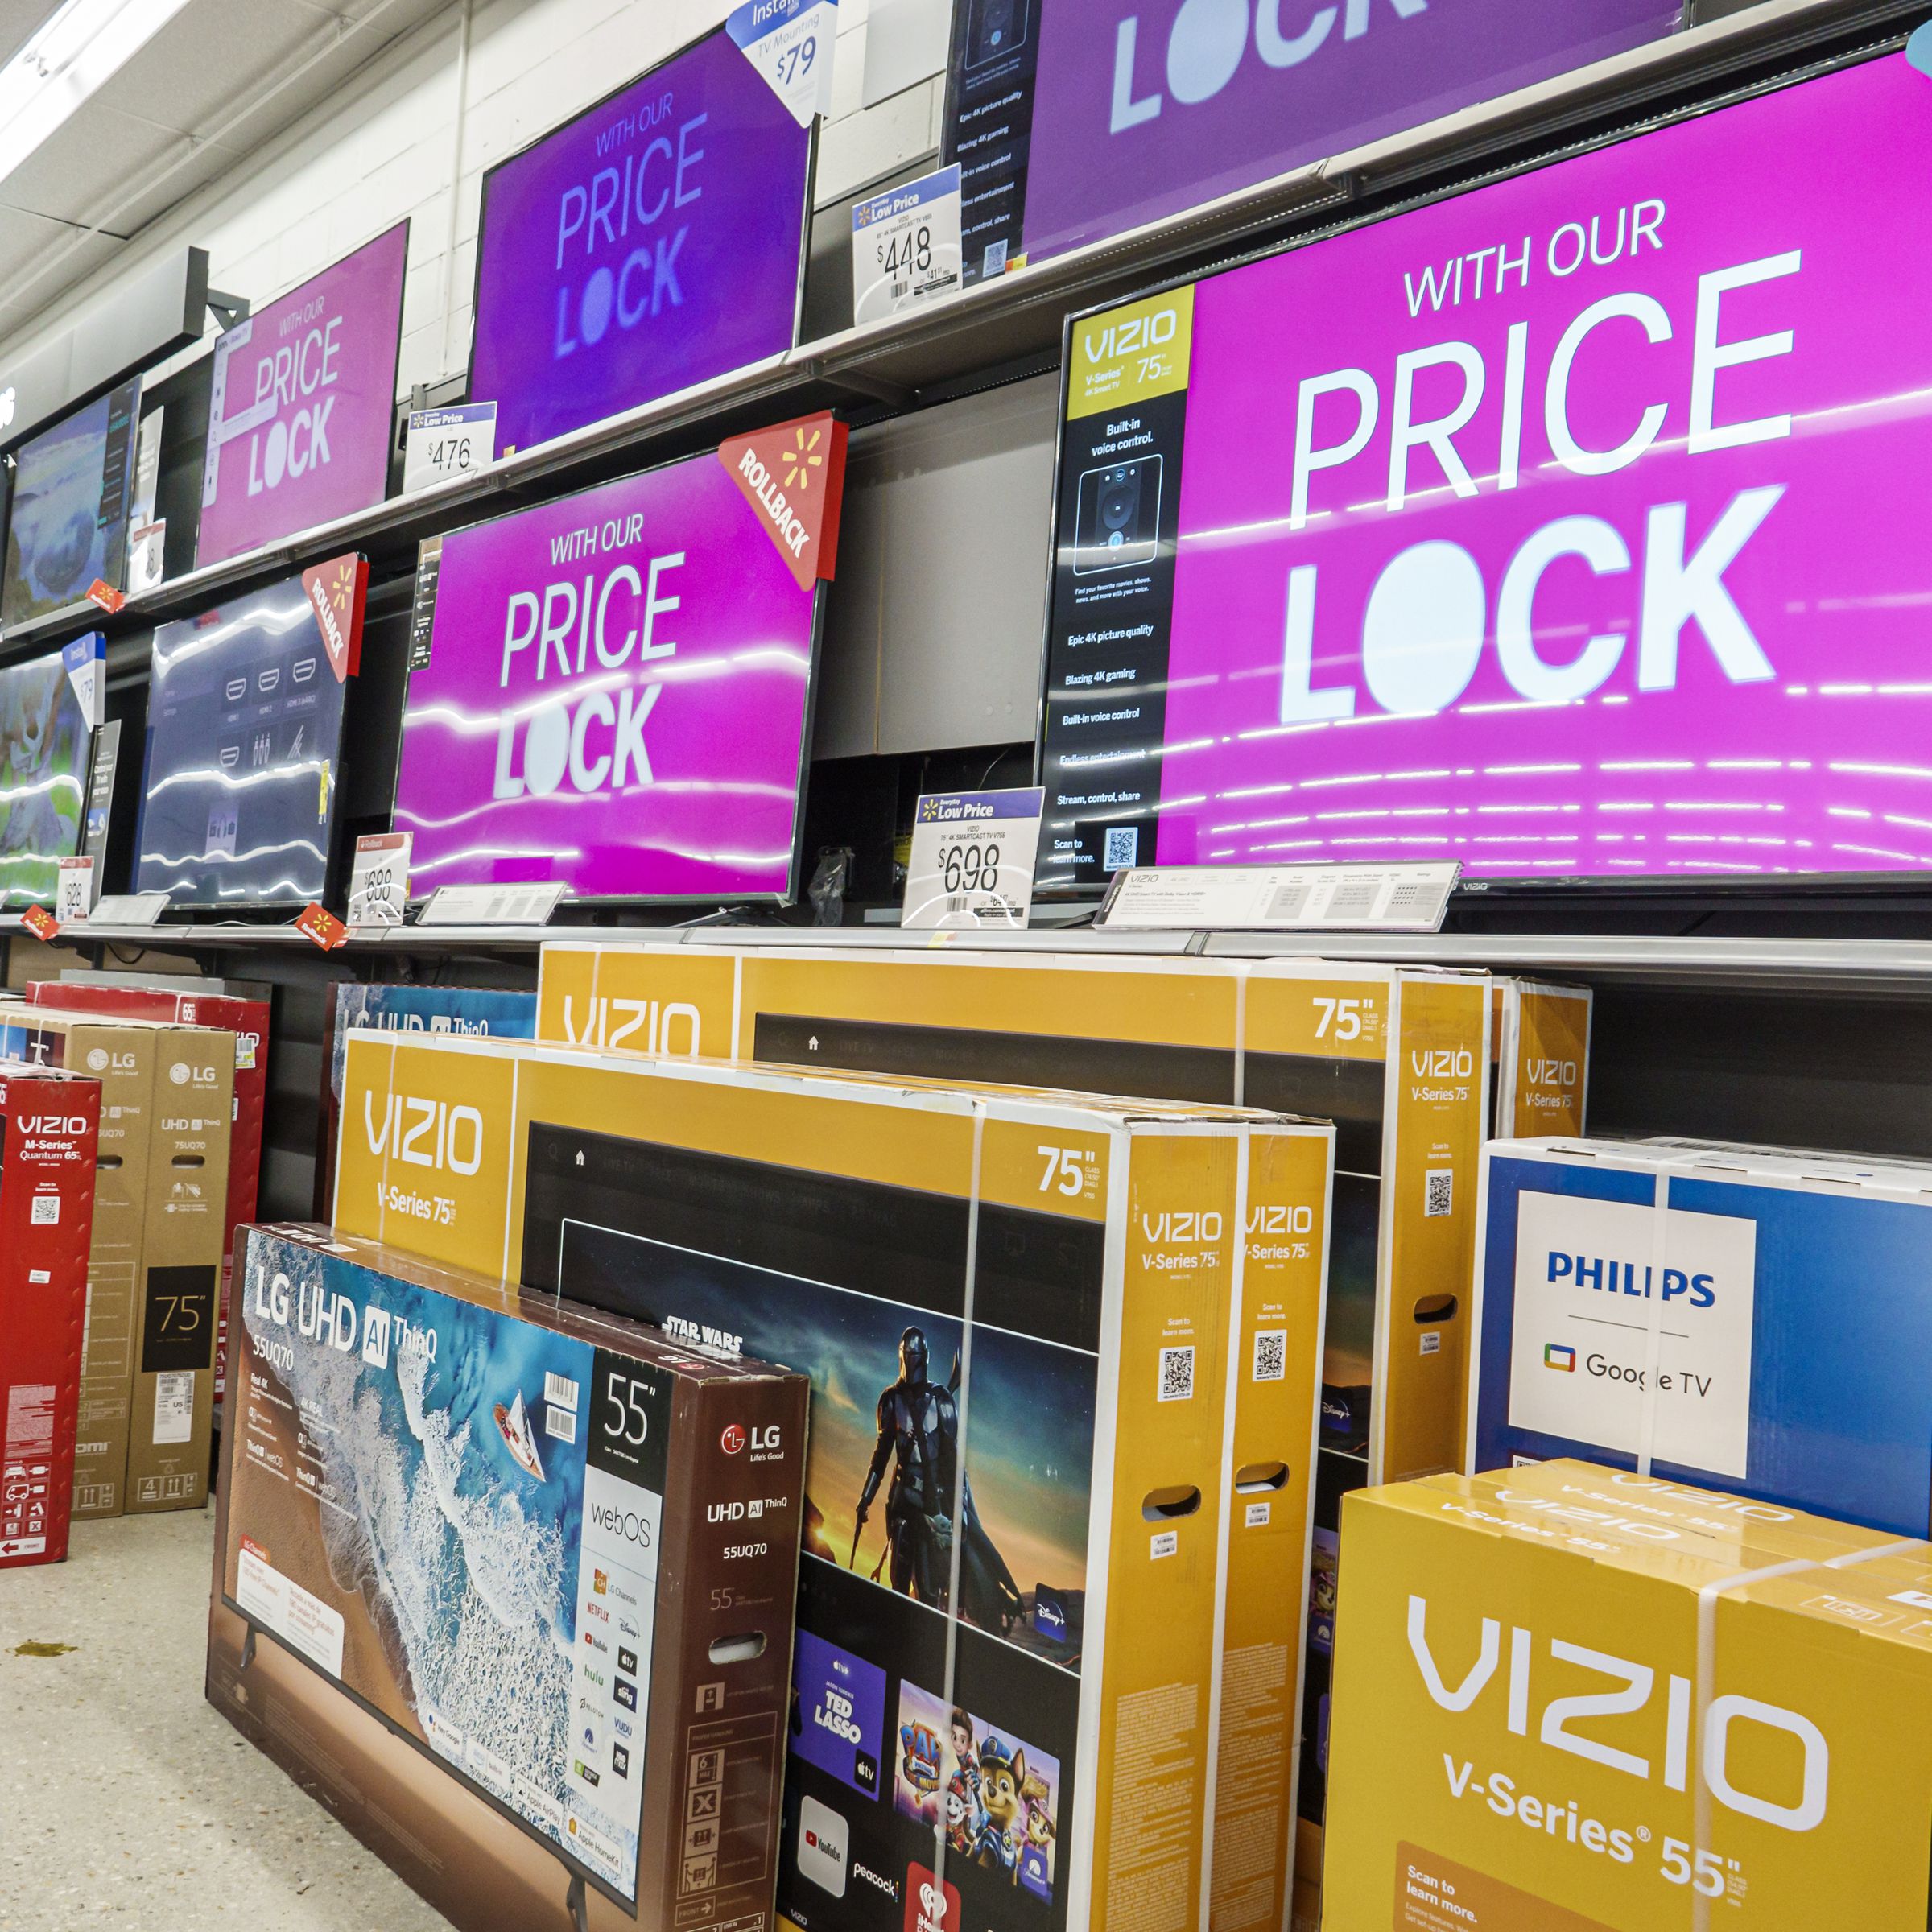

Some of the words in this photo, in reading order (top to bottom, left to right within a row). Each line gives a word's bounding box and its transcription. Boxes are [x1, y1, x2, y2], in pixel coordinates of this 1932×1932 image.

[758, 39, 772, 58] TV
[774, 14, 819, 49] Mounting
[777, 35, 816, 85] $79
[596, 113, 635, 158] WITH
[638, 92, 673, 131] OUR
[556, 111, 708, 270] PRICE
[871, 205, 892, 222] Low
[894, 193, 919, 213] Price
[877, 226, 931, 280] $448
[1402, 236, 1531, 319] WITH
[1546, 197, 1667, 278] OUR
[555, 225, 690, 360] LOCK
[279, 313, 303, 337] WITH
[304, 296, 325, 323] OUR
[1084, 308, 1177, 364] VIZIO
[254, 315, 344, 406] PRICE
[1112, 381, 1120, 389] TV
[1288, 249, 1803, 531] PRICE
[424, 418, 441, 427] Low
[442, 413, 464, 425] Price
[1106, 418, 1141, 436] Built-in
[247, 395, 336, 497] LOCK
[427, 437, 471, 471] $476
[1091, 440, 1116, 457] voice
[1117, 431, 1154, 452] control.
[738, 448, 811, 559] ROLLBACK
[550, 528, 597, 566] WITH
[601, 512, 644, 552] OUR
[312, 577, 345, 659] ROLLBACK
[1279, 483, 1790, 724] LOCK
[499, 551, 686, 688] PRICE
[1067, 634, 1084, 647] Epic
[1085, 632, 1097, 643] 4K
[1097, 630, 1129, 643] picture
[1125, 624, 1154, 639] quality
[1065, 675, 1093, 686] Blazing
[1094, 671, 1105, 682] 4K
[1106, 668, 1137, 683] gaming
[1062, 712, 1090, 726] Built-in
[1090, 711, 1111, 723] voice
[1112, 707, 1140, 720] control
[493, 683, 663, 799] LOCK
[1059, 754, 1089, 766] Endless
[937, 805, 964, 819] Low
[964, 803, 994, 818] Price
[1057, 794, 1087, 806] Stream,
[1088, 791, 1117, 803] control,
[1117, 790, 1141, 802] share
[1054, 839, 1073, 849] Scan
[1074, 838, 1083, 848] to
[938, 844, 1000, 894] $698
[1072, 854, 1096, 863] more.
[1130, 874, 1159, 883] VIZIO
[1463, 882, 1488, 891] VIZIO
[564, 995, 700, 1057] VIZIO
[1312, 997, 1374, 1041] 75"
[111, 1052, 136, 1068] LG
[192, 1067, 216, 1082] LG
[1411, 1050, 1472, 1078] VIZIO
[1526, 1058, 1577, 1086] VIZIO
[1411, 1087, 1455, 1102] V-Series
[1525, 1092, 1561, 1108] V-Series
[17, 1115, 87, 1135] VIZIO
[161, 1118, 189, 1131] UHD
[365, 1090, 483, 1176] VIZIO
[19, 1150, 63, 1161] Quantum
[175, 1141, 206, 1150] 75UQ70
[1038, 1145, 1095, 1196] 75"
[377, 1182, 431, 1221] V-Series
[1142, 1212, 1223, 1243] VIZIO
[1141, 1253, 1198, 1270] V-Series
[1546, 1249, 1716, 1309] PHILIPS
[155, 1294, 206, 1332] 75"
[255, 1265, 290, 1326] LG
[298, 1280, 357, 1352] UHD
[394, 1315, 439, 1364] ThinQ
[1167, 1317, 1183, 1326] Scan
[1183, 1317, 1191, 1326] to
[662, 1315, 701, 1341] STAR
[701, 1325, 743, 1352] WARS
[1162, 1328, 1178, 1336] learn
[252, 1333, 295, 1371] 55UQ70
[1679, 1372, 1712, 1397] TV
[604, 1372, 656, 1445] 55"
[750, 1425, 781, 1450] LG
[750, 1452, 766, 1462] Life's
[767, 1451, 784, 1461] Good
[145, 1478, 155, 1492] 4
[1611, 1472, 1795, 1522] VIZIO
[707, 1502, 745, 1522] UHD
[765, 1497, 788, 1509] ThinQ
[1560, 1484, 1674, 1518] V-Series
[591, 1501, 651, 1548] webOS
[1440, 1502, 1555, 1538] V-Series
[1495, 1490, 1682, 1542] VIZIO
[723, 1543, 768, 1559] 55UQ70
[608, 1583, 615, 1594] LG
[615, 1587, 638, 1606] Channels
[587, 1600, 609, 1624] NETFLIX
[1036, 1602, 1066, 1628] Disney+
[584, 1663, 605, 1686] hulu
[825, 1690, 853, 1718] TED
[1406, 1593, 1829, 1832] VIZIO
[613, 1716, 633, 1736] VUDU
[814, 1705, 861, 1745] LASSO
[699, 1756, 708, 1769] 6
[865, 1761, 875, 1781] tv
[578, 1831, 594, 1849] Apple
[594, 1842, 620, 1865] HomeKit
[817, 1835, 841, 1862] YouTube
[853, 1862, 895, 1897] peacock
[1407, 1864, 1439, 1889] Scan
[1441, 1880, 1455, 1896] to
[1659, 1835, 1740, 1898] 55"
[1406, 1880, 1439, 1906] learn
[1441, 1899, 1478, 1923] more.
[1406, 1901, 1428, 1918] Explore
[790, 1908, 807, 1926] VIZIO
